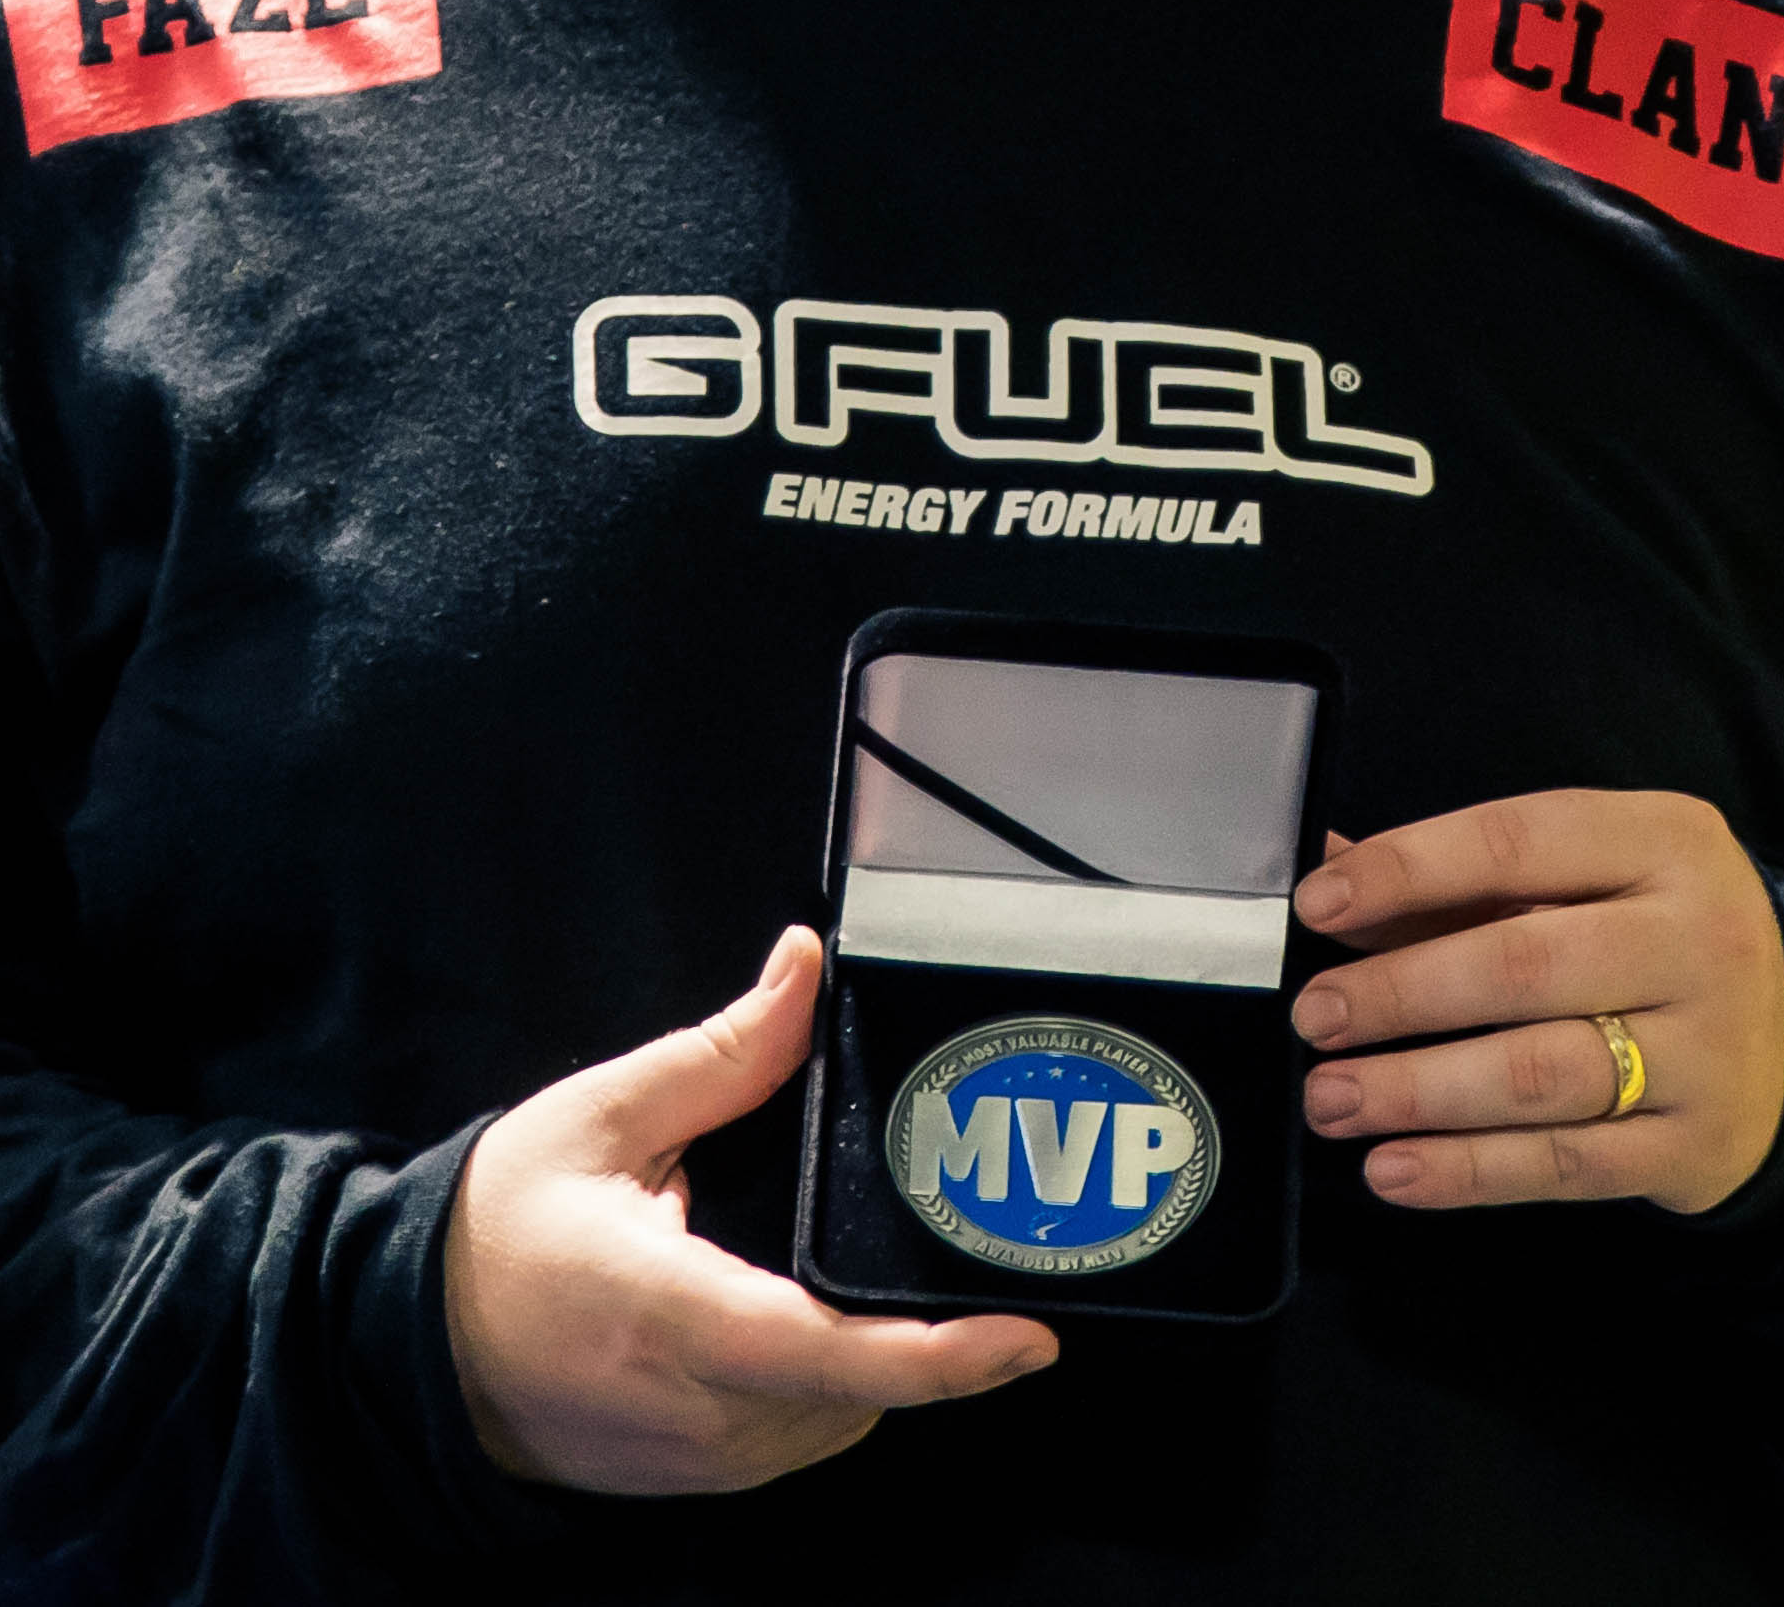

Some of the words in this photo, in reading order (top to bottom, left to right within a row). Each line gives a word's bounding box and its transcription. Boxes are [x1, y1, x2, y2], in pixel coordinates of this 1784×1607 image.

[762, 473, 988, 535] ENERGY
[993, 489, 1263, 545] FORMULA
[962, 1039, 1003, 1066] MOST
[1005, 1033, 1089, 1051] VALUABLE
[1092, 1041, 1150, 1076] PLAYER
[909, 1091, 1197, 1210] MVP
[974, 1241, 1055, 1271] AWARDED
[1058, 1255, 1080, 1271] BY
